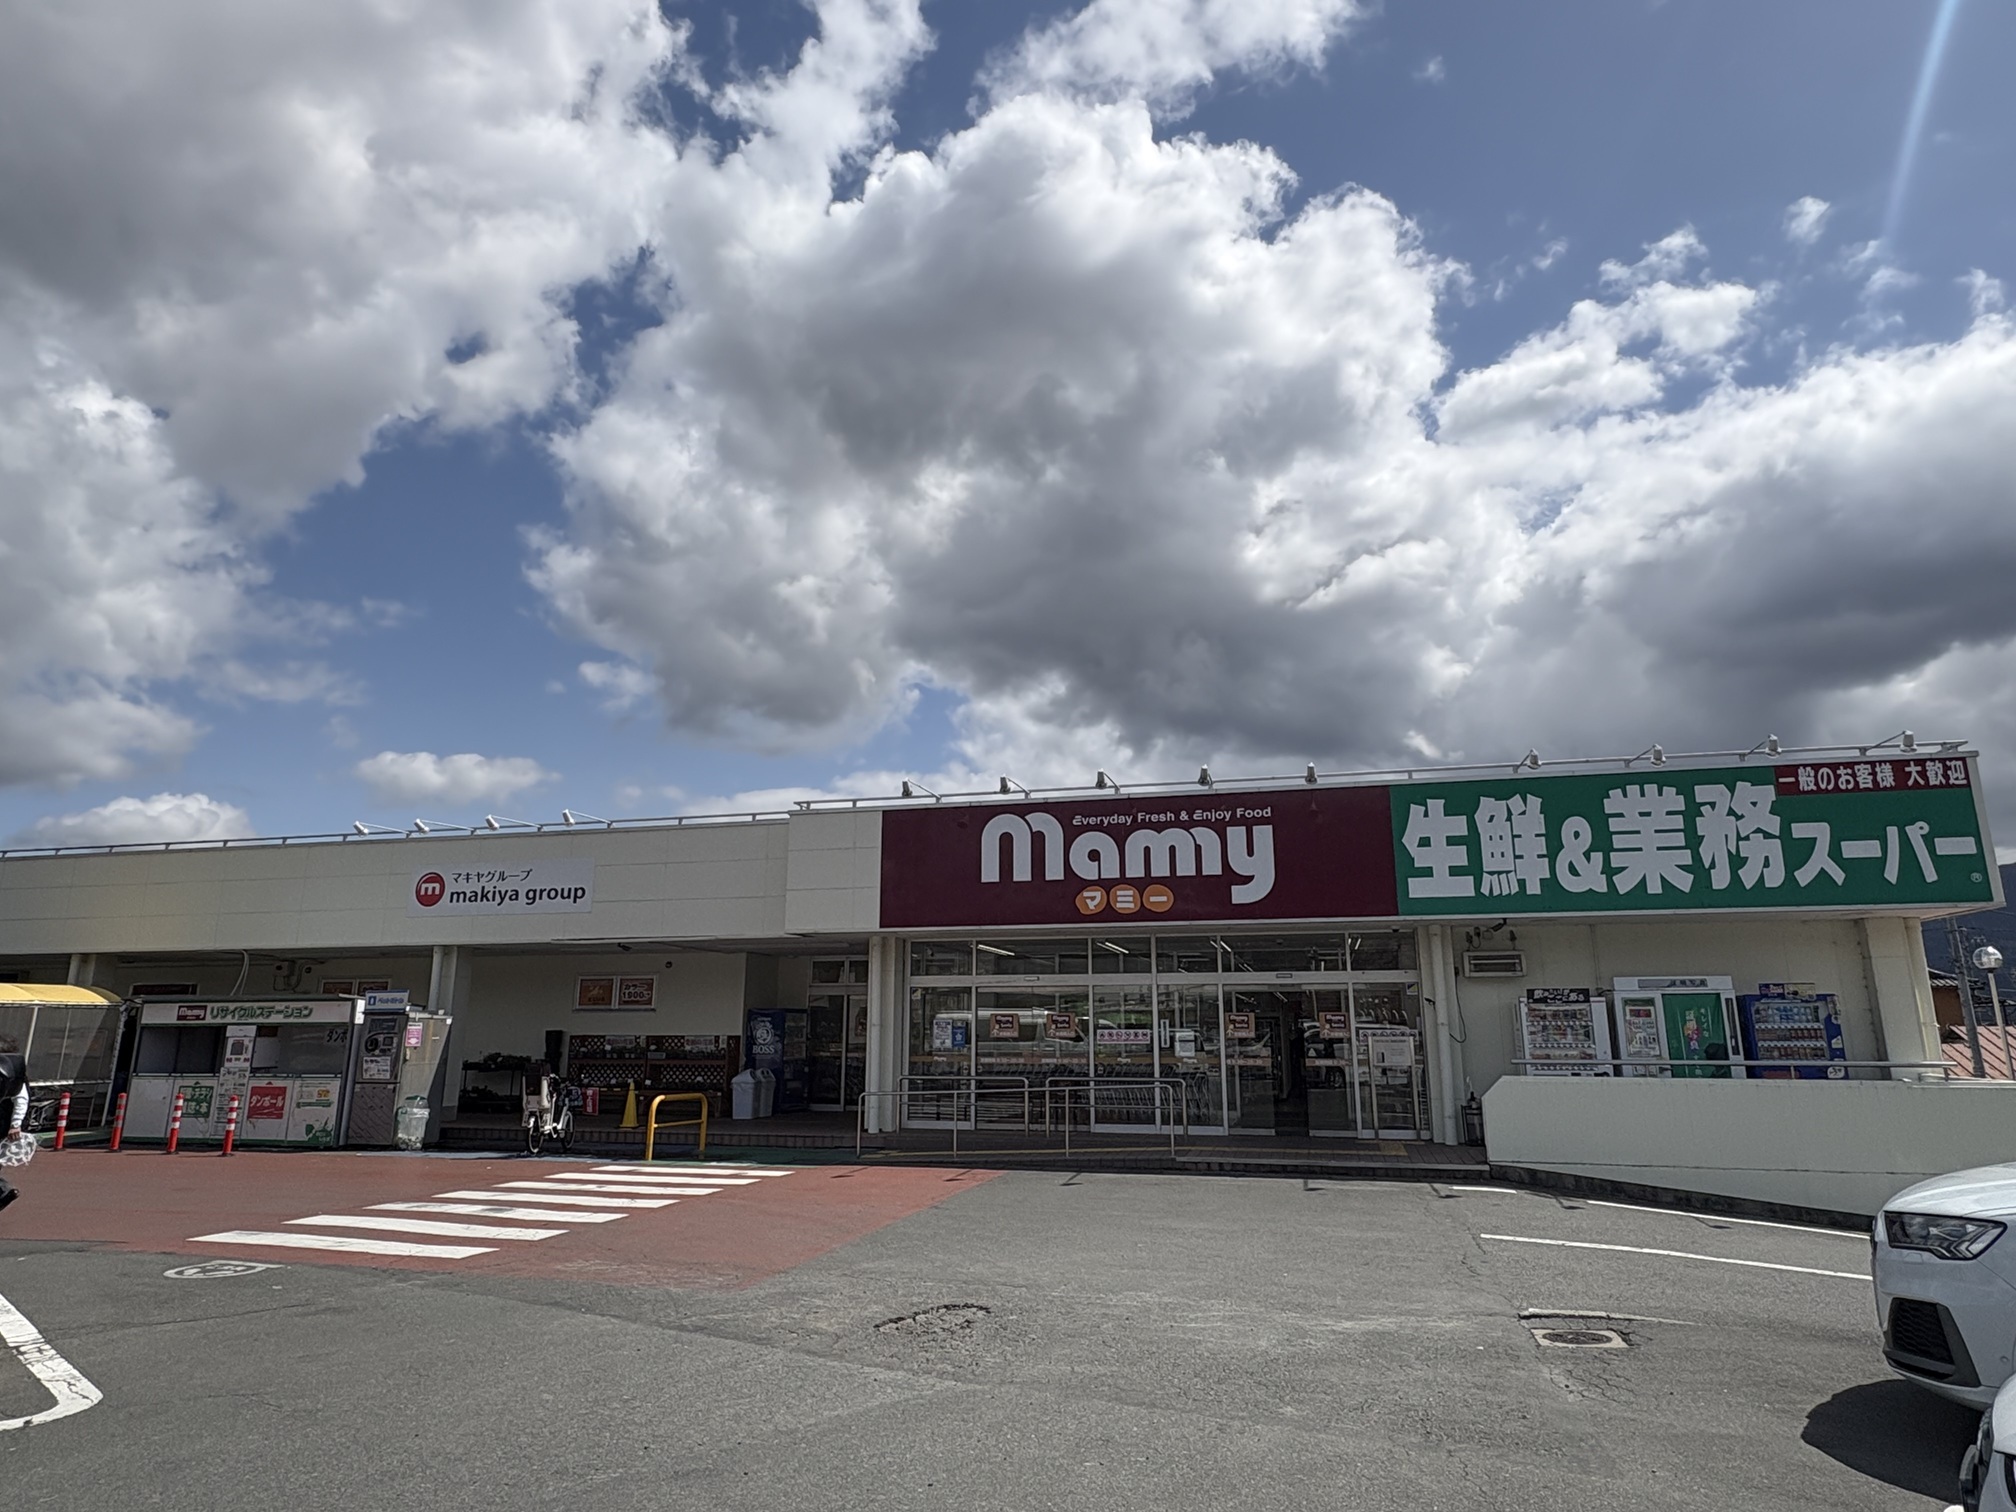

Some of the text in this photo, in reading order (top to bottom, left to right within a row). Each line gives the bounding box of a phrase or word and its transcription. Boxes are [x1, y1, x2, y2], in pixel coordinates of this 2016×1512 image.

[1778, 759, 1968, 791] 一般のお客様 大歓迎
[1072, 806, 1272, 826] Everyday Fresh & Enjoy Food
[451, 868, 533, 884] マキヤグループ
[449, 885, 586, 906] makiya group
[1082, 889, 1168, 910] マミー
[209, 1005, 313, 1019] リサイクルステーション
[752, 1045, 775, 1054] BOSS
[250, 1095, 285, 1107] ダンボール
